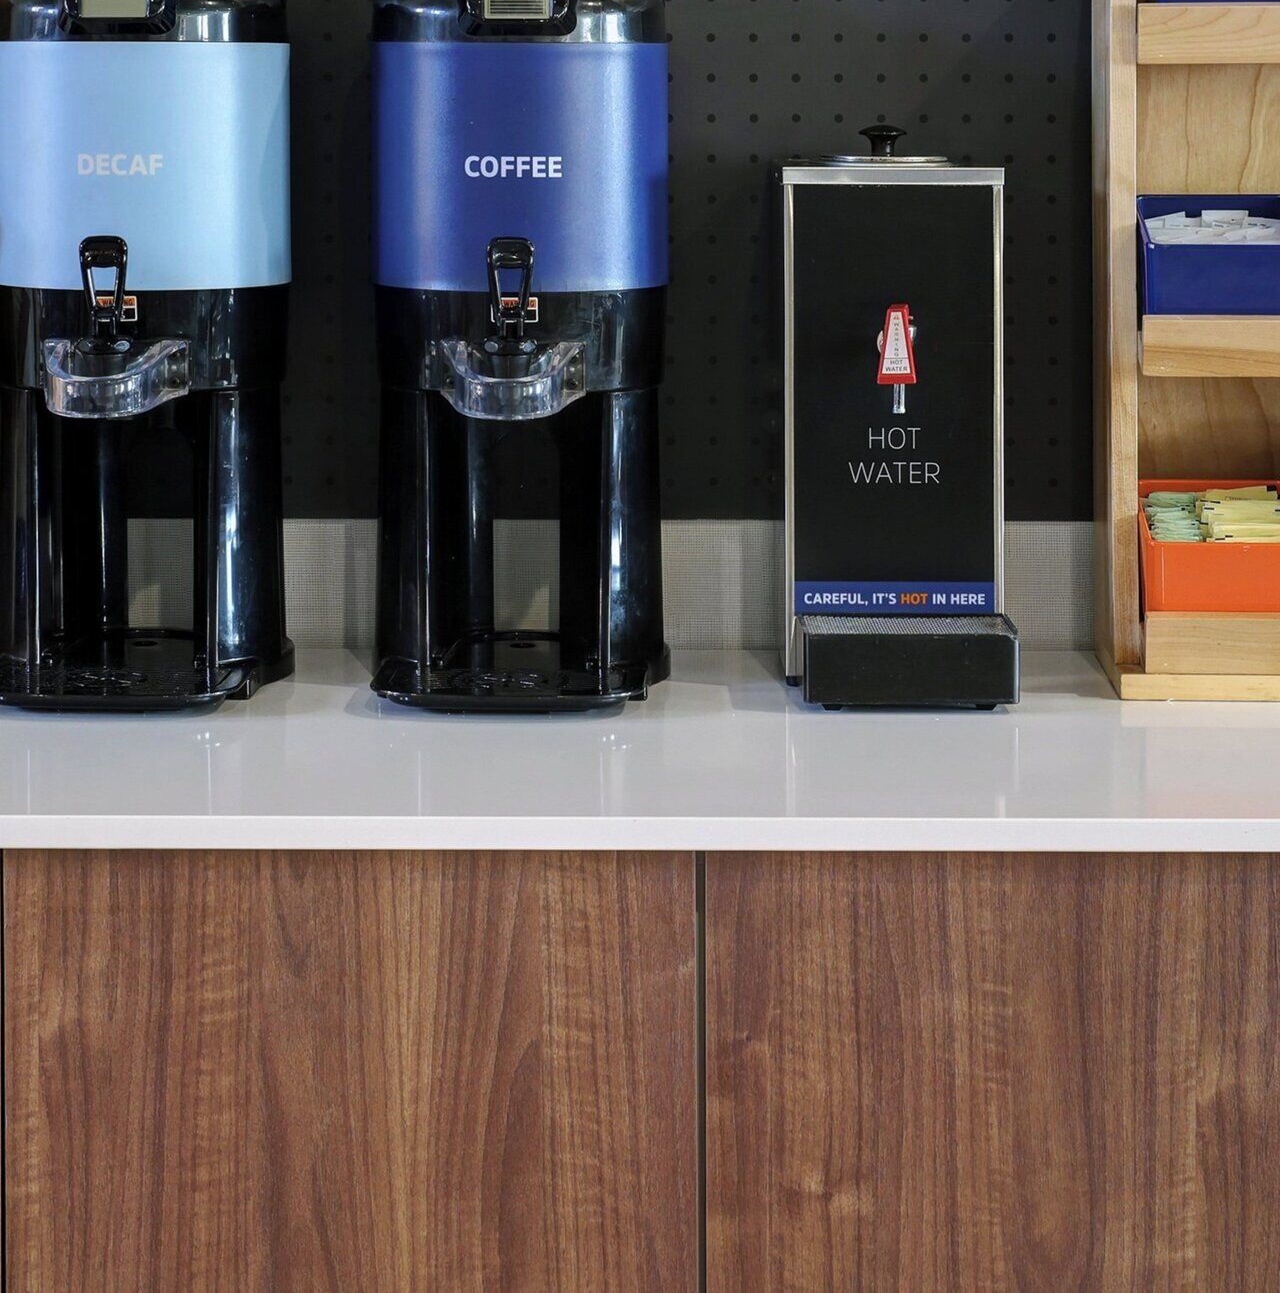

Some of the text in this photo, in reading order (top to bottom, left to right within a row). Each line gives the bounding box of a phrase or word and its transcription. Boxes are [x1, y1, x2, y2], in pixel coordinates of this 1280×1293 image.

[77, 153, 164, 176] DECAF
[464, 155, 563, 178] COFFEE
[868, 426, 922, 450] HOT
[848, 461, 941, 484] WATER
[803, 592, 986, 607] CAREFUL, IT'S HOT IN HERE
